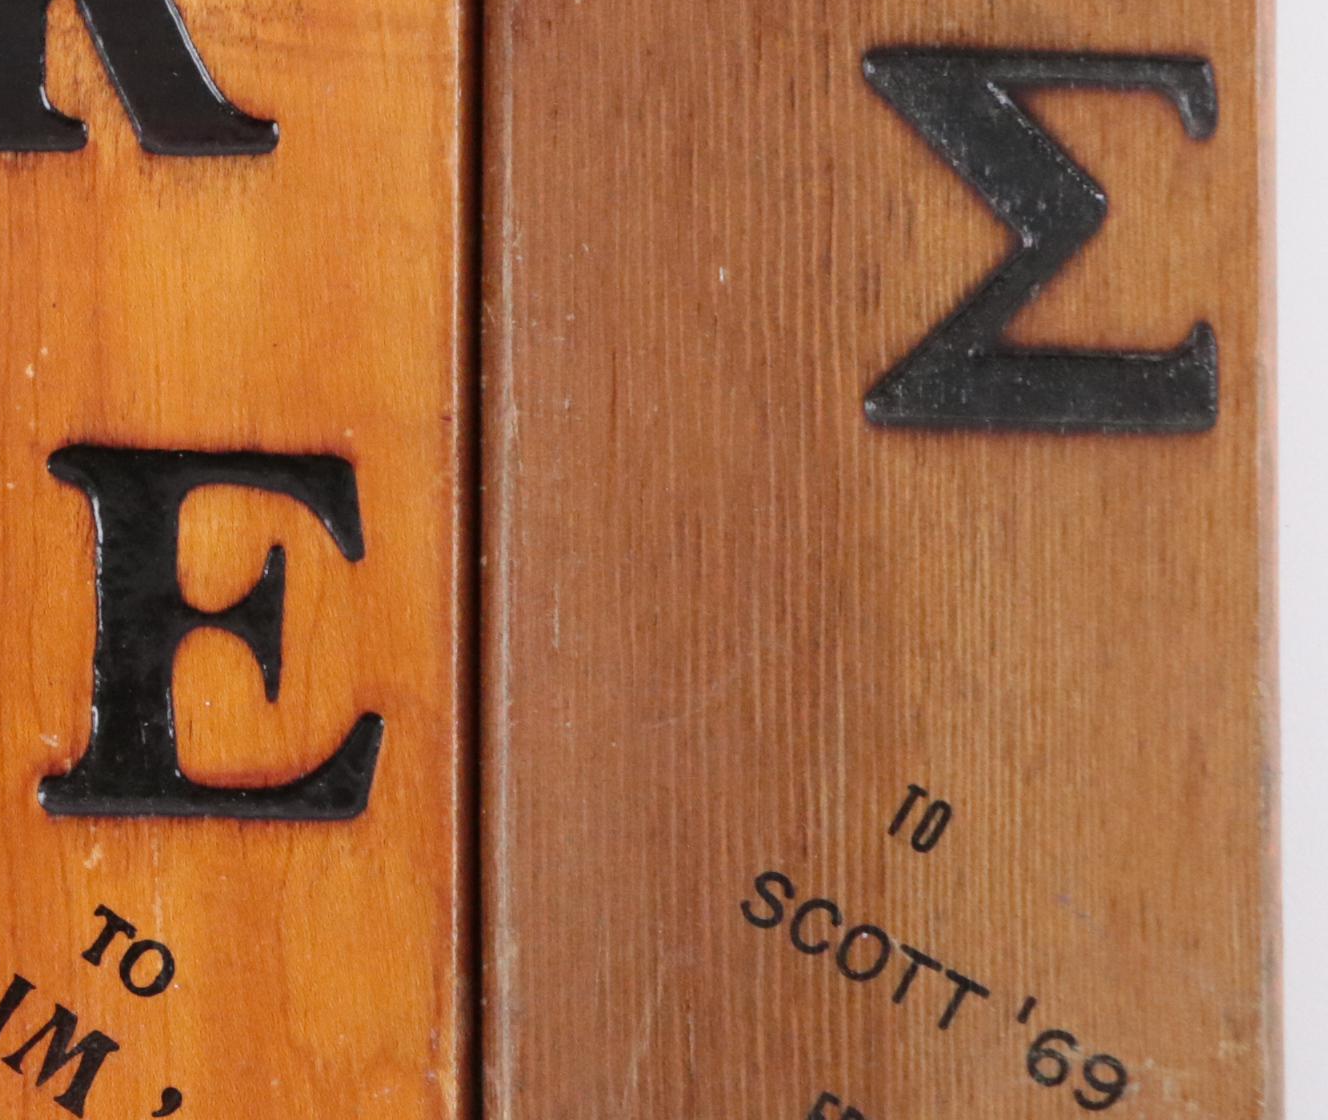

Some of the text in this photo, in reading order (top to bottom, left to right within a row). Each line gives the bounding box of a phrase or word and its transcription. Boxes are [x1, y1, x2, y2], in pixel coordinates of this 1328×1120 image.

[888, 783, 954, 853] TO
[81, 904, 176, 998] TO
[740, 871, 1128, 1111] SCOTT '69
